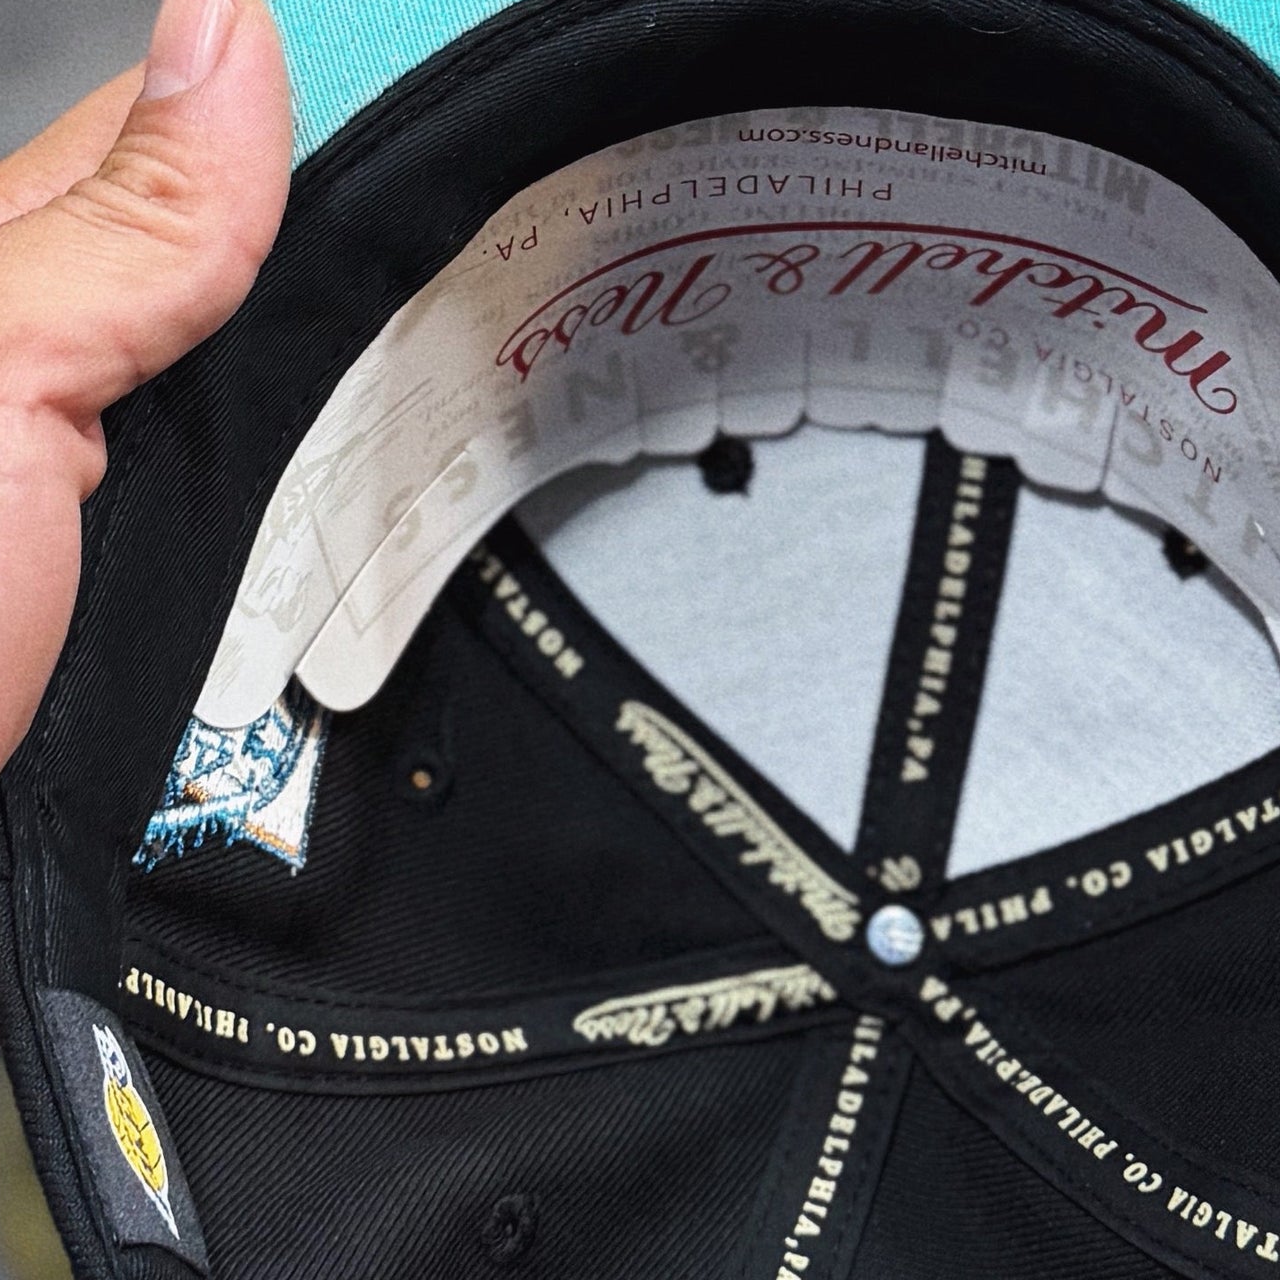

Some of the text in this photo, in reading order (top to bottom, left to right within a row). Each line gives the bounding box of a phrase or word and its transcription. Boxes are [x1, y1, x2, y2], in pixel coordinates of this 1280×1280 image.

[737, 126, 1047, 177] mitchellandness.com
[562, 172, 894, 226] PHILADELPHIA,
[482, 227, 540, 262] PA.
[496, 239, 1239, 417] Mitchell & Ness
[1033, 342, 1224, 486] NOSTALGIA
[1066, 861, 1132, 897] CO.
[122, 967, 529, 1061] NOSTALGIA CO. PHILADELP
[1122, 1152, 1163, 1194] CO.
